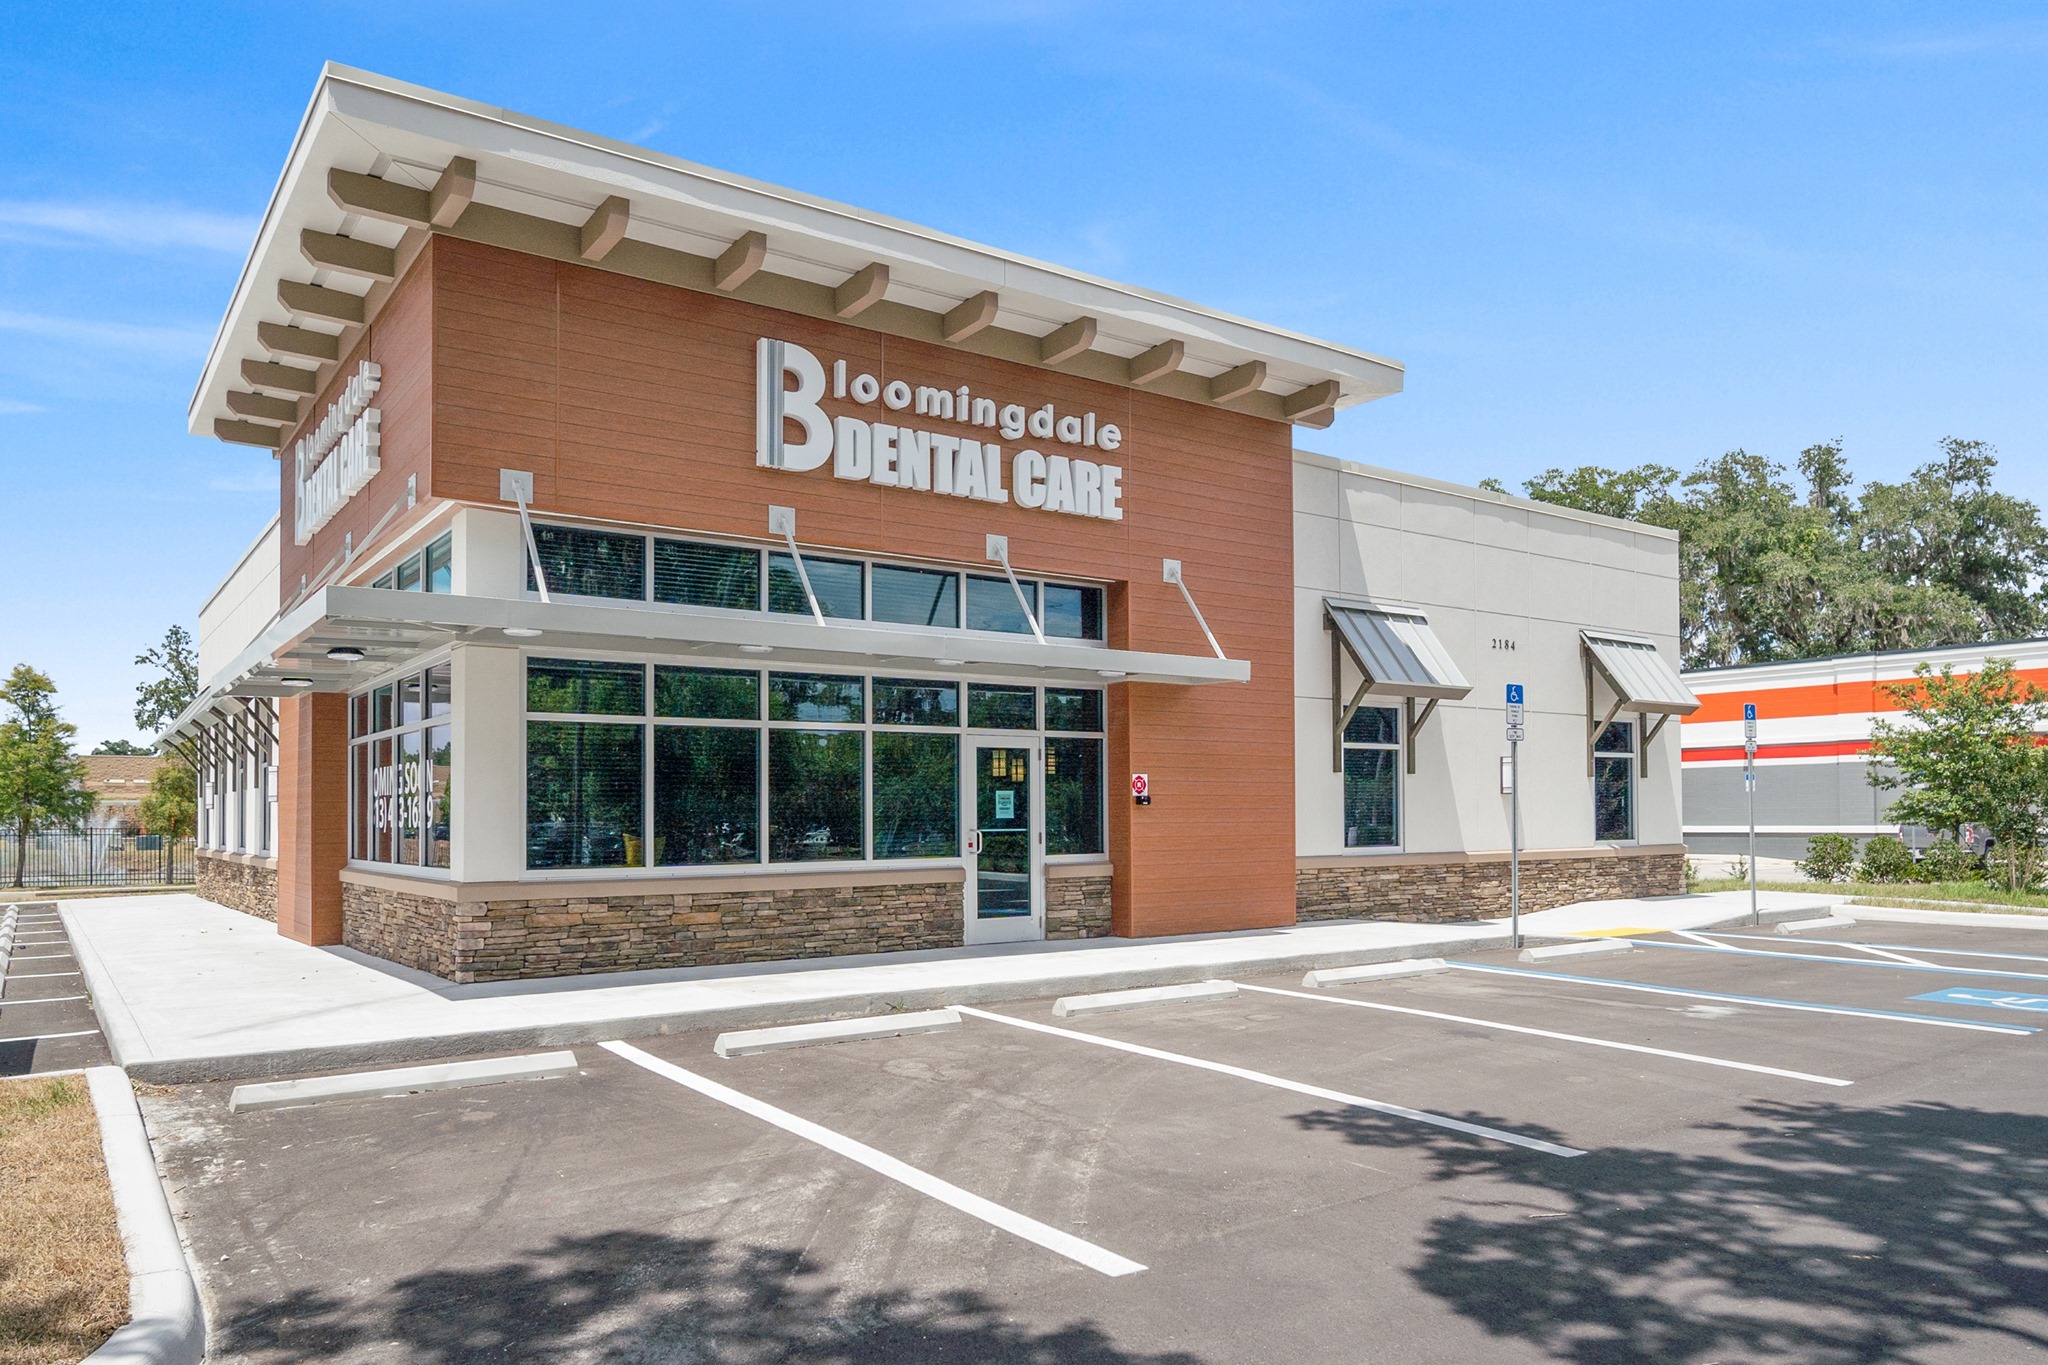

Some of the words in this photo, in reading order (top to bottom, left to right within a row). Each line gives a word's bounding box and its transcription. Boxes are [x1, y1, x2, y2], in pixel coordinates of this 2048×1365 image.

[756, 337, 1122, 472] Bloomingdale
[834, 416, 1008, 503] DENTAL
[1012, 449, 1123, 521] CARE
[1491, 638, 1516, 651] 2184
[404, 759, 434, 795] SON
